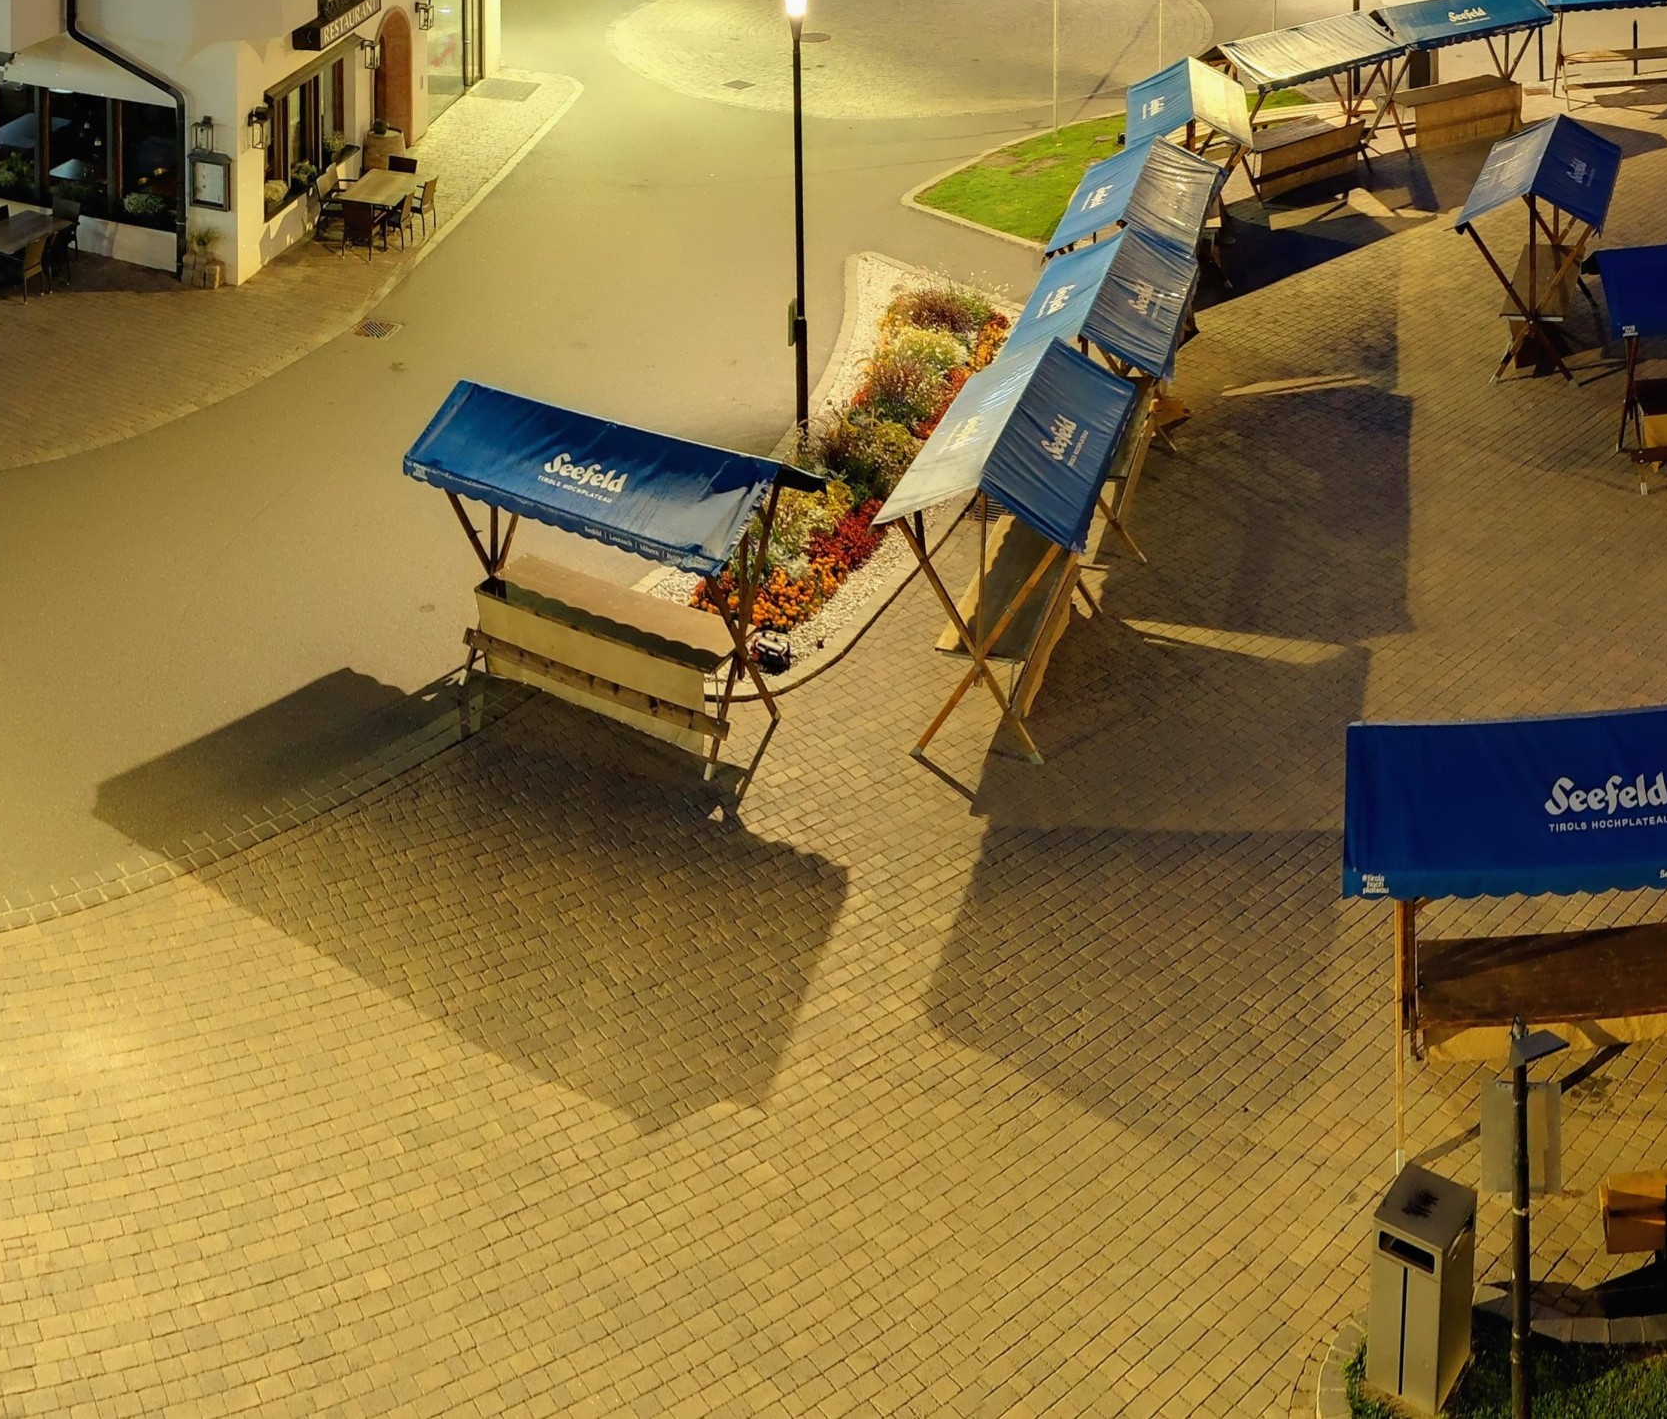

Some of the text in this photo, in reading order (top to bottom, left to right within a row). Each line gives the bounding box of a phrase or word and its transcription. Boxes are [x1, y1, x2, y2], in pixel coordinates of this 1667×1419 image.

[1448, 6, 1487, 23] Seefeld
[1041, 413, 1077, 461] Seefeld
[544, 453, 628, 494] Seefeld
[1549, 821, 1587, 833] TIROLS
